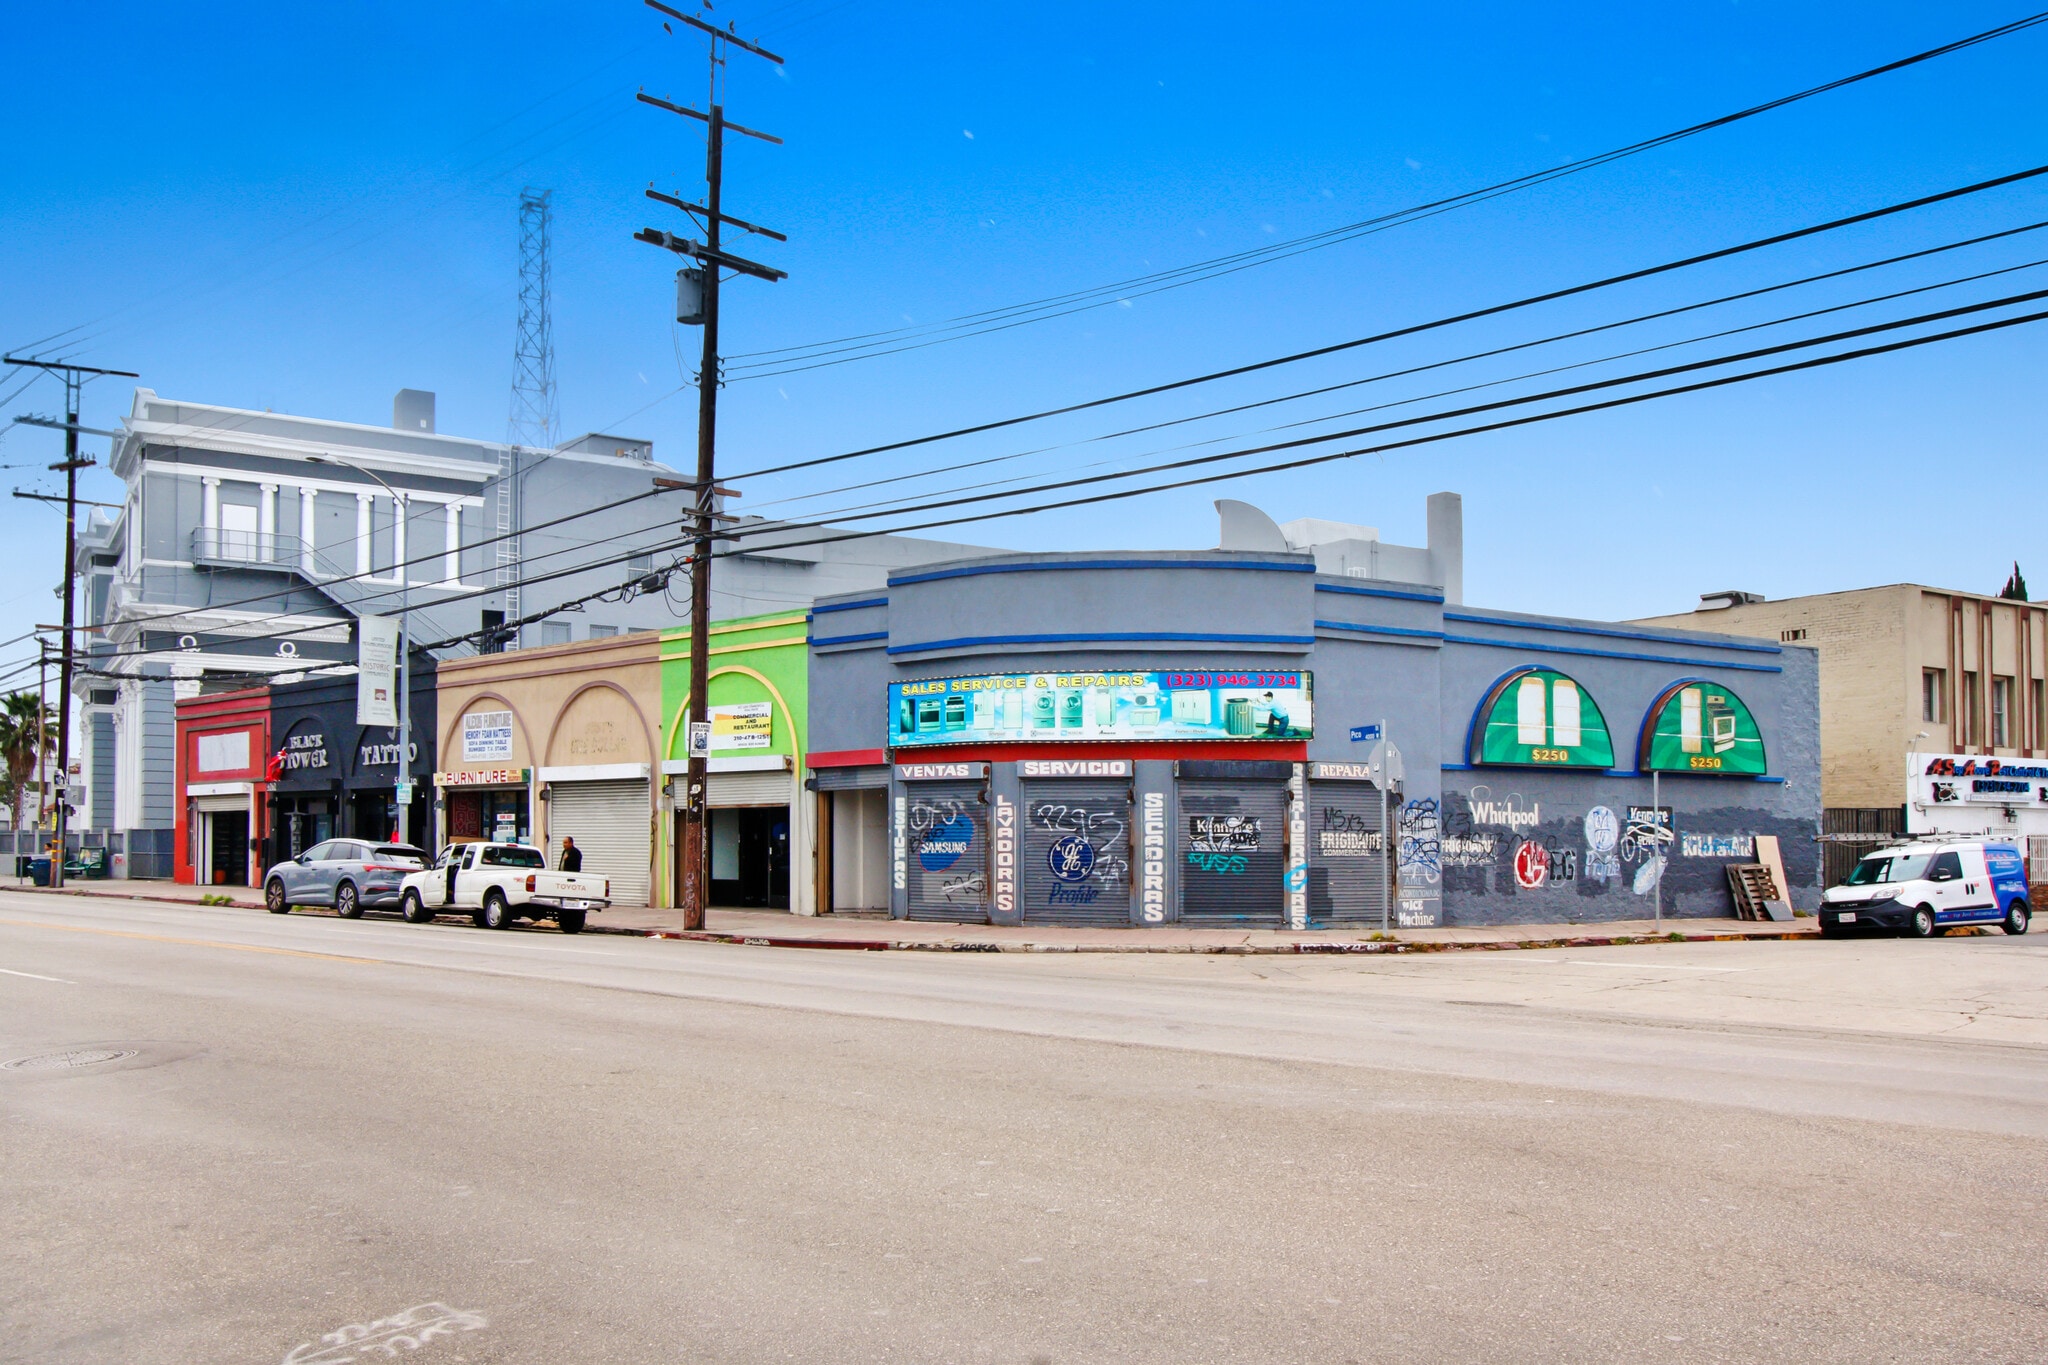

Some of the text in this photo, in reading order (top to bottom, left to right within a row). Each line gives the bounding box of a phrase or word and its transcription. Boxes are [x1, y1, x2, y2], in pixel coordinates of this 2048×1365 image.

[363, 662, 391, 672] HISTORIC
[902, 673, 1145, 696] SALES SERVICE & REPAIRS
[1166, 673, 1298, 688] (323) 946-3734
[733, 723, 770, 731] RESTAURANT
[290, 734, 323, 749] BLACK
[1351, 731, 1362, 739] Pico
[287, 749, 328, 769] TOWER
[361, 743, 418, 766] TATTO
[1532, 749, 1568, 761] $250
[1024, 762, 1126, 775] SERVICIO
[1690, 757, 1721, 768] $250
[447, 770, 507, 784] FURNITURE
[902, 764, 969, 778] VENTAS
[1320, 764, 1370, 777] REPARA
[2010, 765, 2035, 777] Control
[1468, 801, 1539, 832] Whirlpool
[1630, 807, 1669, 823] Kenmre
[1197, 820, 1253, 833] Knmre
[895, 797, 906, 889] ESTUFAS
[920, 841, 967, 854] SAMSUNG
[997, 795, 1014, 911] LAVADORAS
[1144, 792, 1165, 922] SECADORAS
[1048, 881, 1100, 906] Profile
[1398, 913, 1434, 927] Machine
